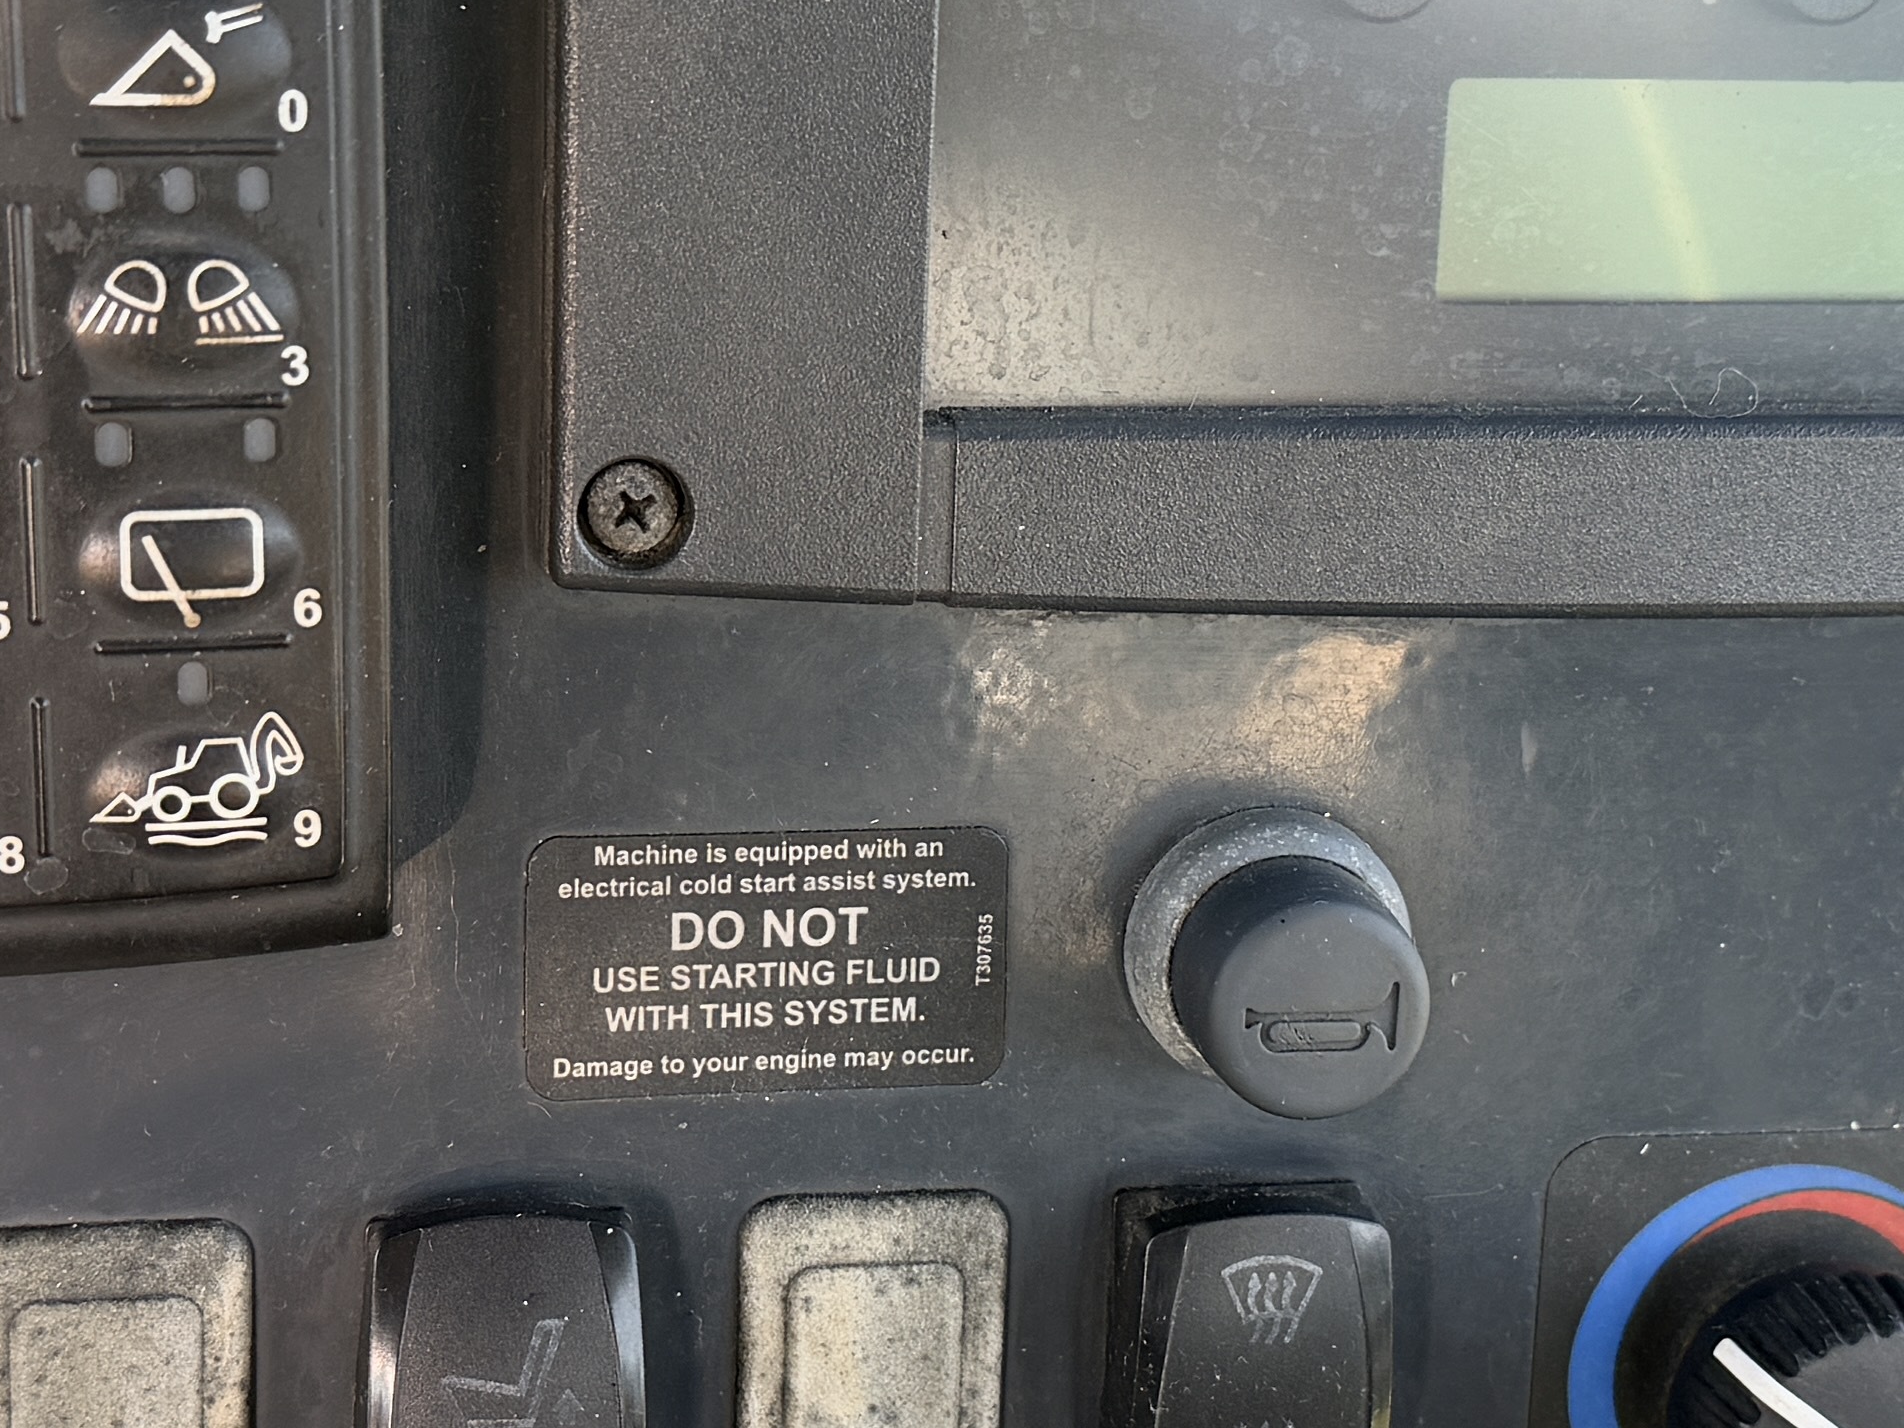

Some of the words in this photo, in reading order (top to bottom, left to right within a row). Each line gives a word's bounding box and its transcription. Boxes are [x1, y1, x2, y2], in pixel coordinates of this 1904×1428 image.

[277, 88, 308, 133] 0
[280, 345, 310, 386] 3
[293, 587, 323, 626] 6
[293, 809, 322, 848] 9
[594, 843, 698, 866] Machine
[706, 842, 727, 864] is
[734, 840, 849, 867] equipped
[856, 837, 907, 859] with
[914, 841, 944, 858] an
[558, 875, 671, 899] electrical
[679, 873, 732, 896] cold
[739, 872, 796, 894] start
[802, 871, 876, 892] assist
[882, 870, 976, 895] system.
[671, 910, 745, 951] DO
[762, 906, 869, 948] NOT
[975, 913, 994, 987] T307635
[592, 965, 660, 994] USE
[670, 960, 835, 991] STARTING
[846, 956, 941, 985] FLUID
[604, 1004, 689, 1033] WITH
[699, 1001, 774, 1029] THIS
[783, 996, 926, 1026] SYSTEM.
[553, 1057, 653, 1081] Damage
[660, 1055, 685, 1075] to
[692, 1055, 749, 1078] your
[754, 1048, 837, 1075] engine
[844, 1050, 895, 1071] may
[901, 1047, 974, 1065] occur.
